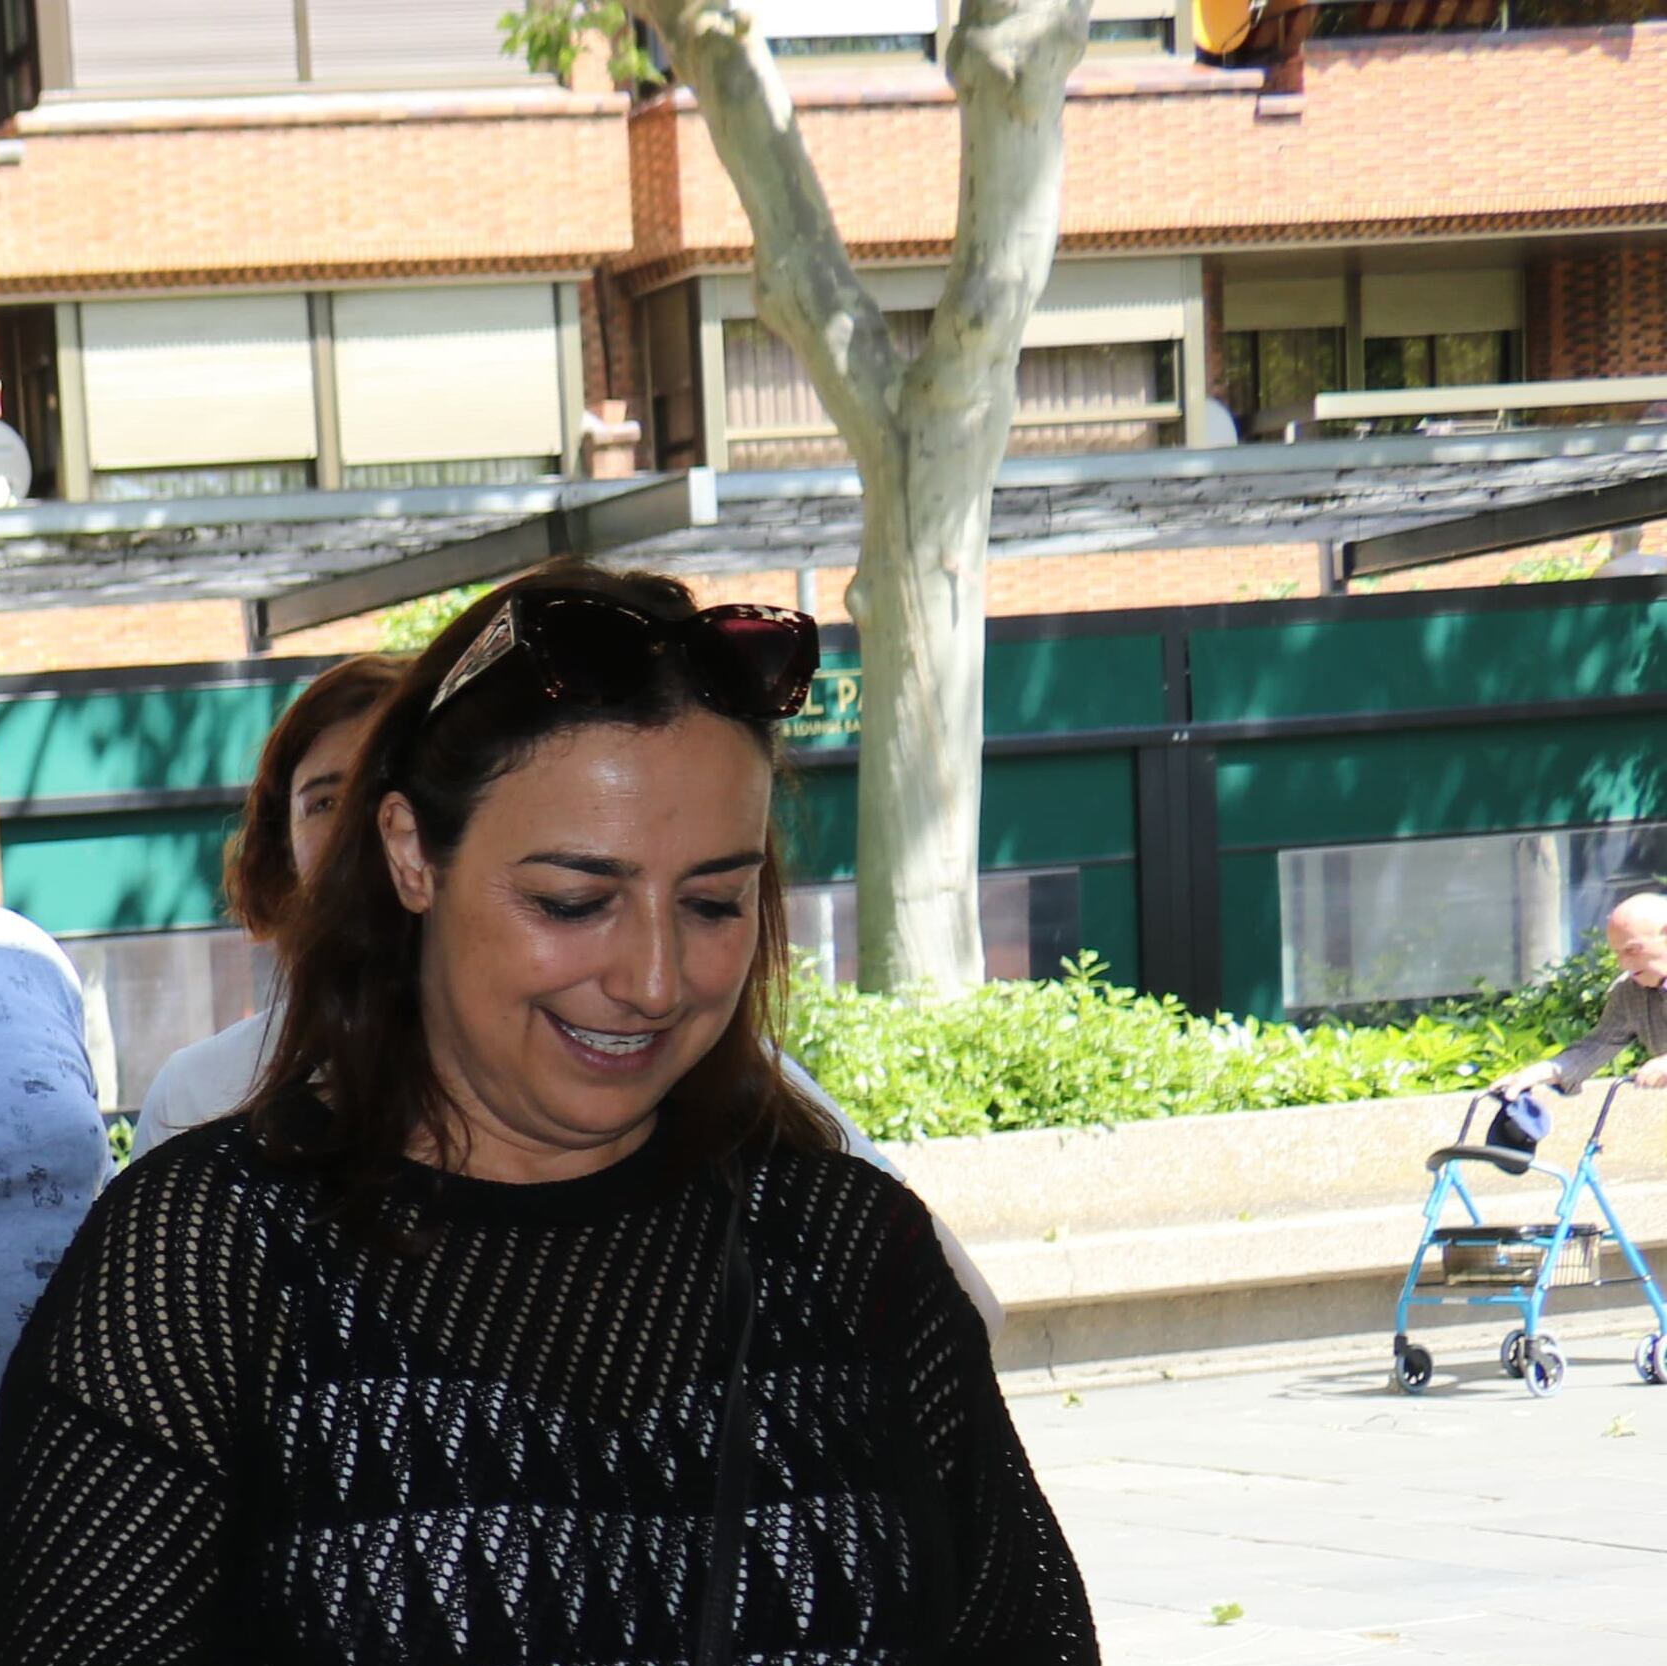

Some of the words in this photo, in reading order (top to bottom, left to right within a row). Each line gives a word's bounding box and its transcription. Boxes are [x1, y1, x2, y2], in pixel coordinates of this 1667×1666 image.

[798, 683, 824, 715] L
[836, 677, 863, 714] P
[844, 718, 862, 734] BA
